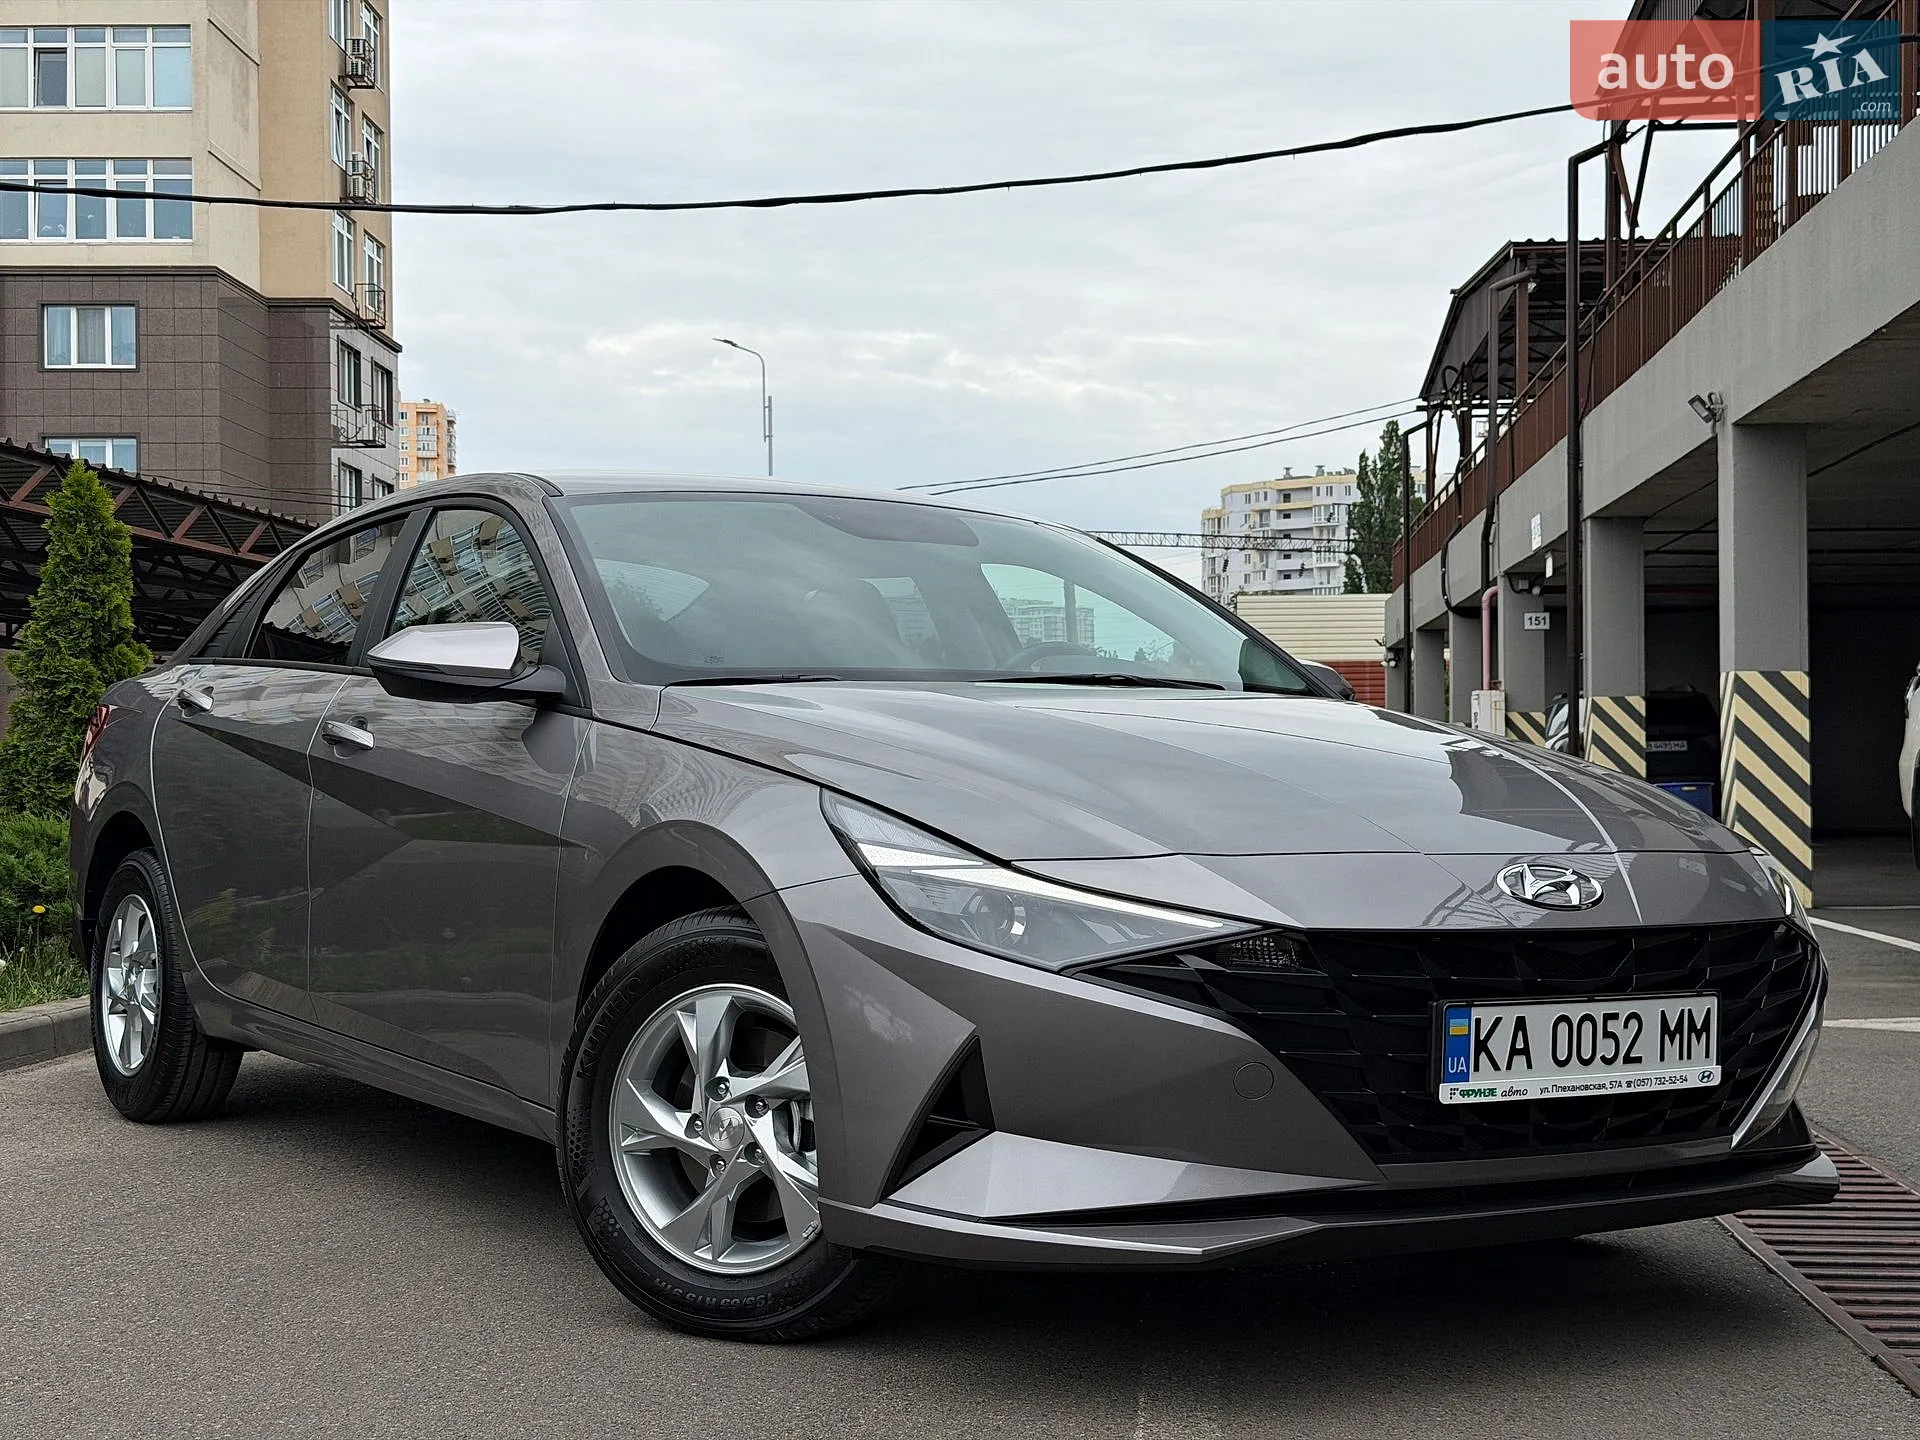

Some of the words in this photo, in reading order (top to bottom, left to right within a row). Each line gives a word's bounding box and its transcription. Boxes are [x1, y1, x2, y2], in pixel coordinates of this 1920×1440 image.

[1527, 616, 1547, 627] 151
[1472, 1015, 1533, 1073] KA
[1551, 1011, 1643, 1068] 0052
[1659, 1006, 1711, 1062] MM
[1448, 1056, 1468, 1074] UA
[1459, 1087, 1497, 1099] ФРУНЗЕ
[1501, 1086, 1528, 1097] авто
[1539, 1086, 1551, 1095] ул.
[1551, 1082, 1608, 1093] Плехановская,
[1633, 1077, 1653, 1088] (057)
[1654, 1074, 1688, 1086] 732-52-54
